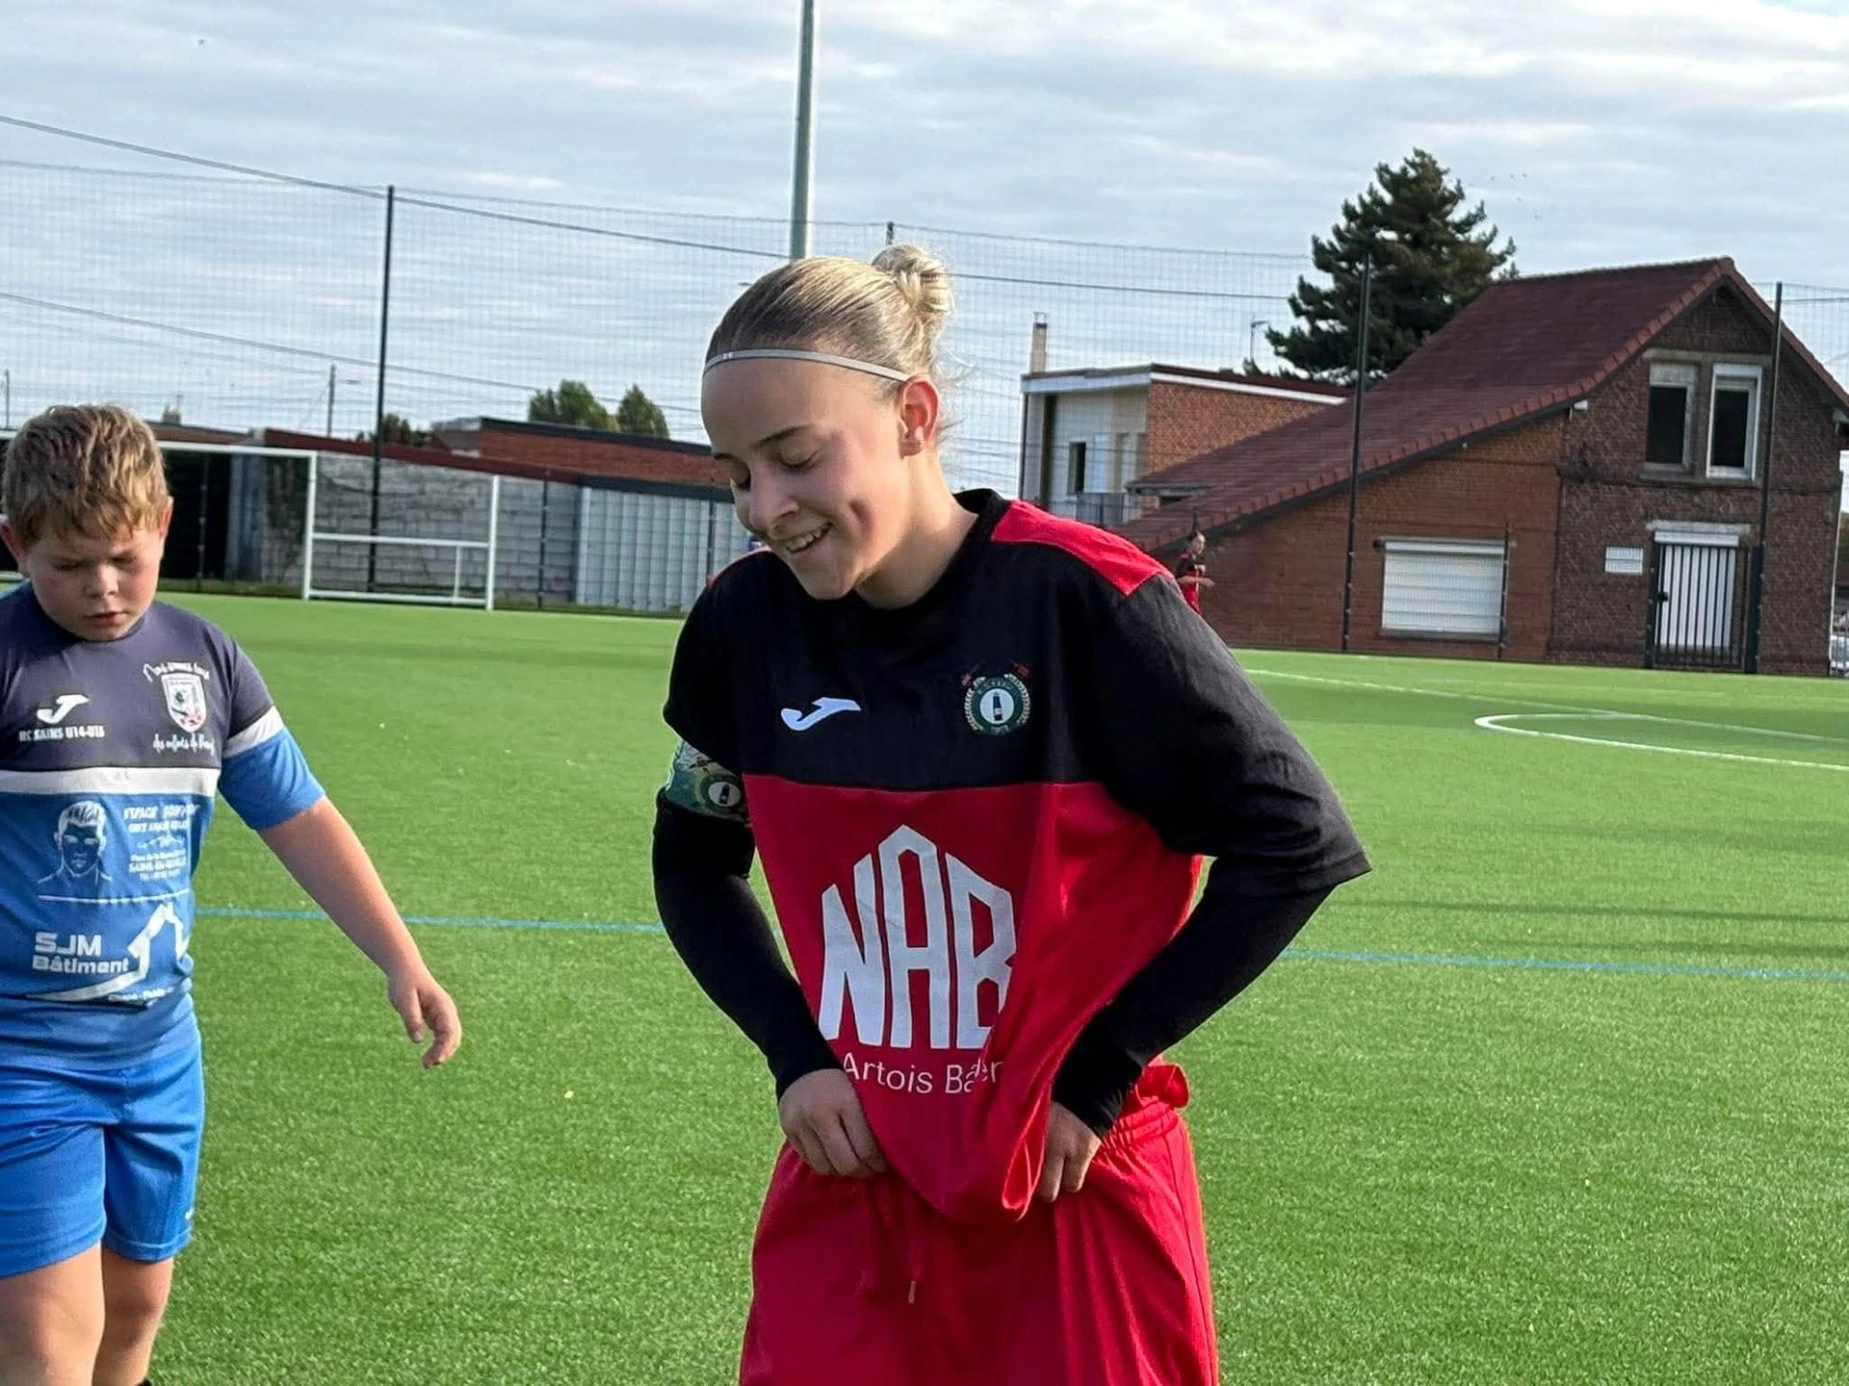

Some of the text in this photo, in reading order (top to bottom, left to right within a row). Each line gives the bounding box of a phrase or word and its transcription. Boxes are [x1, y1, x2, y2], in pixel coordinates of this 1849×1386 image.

[34, 931, 102, 956] SJM
[818, 824, 1017, 1049] NAB
[32, 954, 129, 974] Bâtiment
[843, 1052, 933, 1094] Artois
